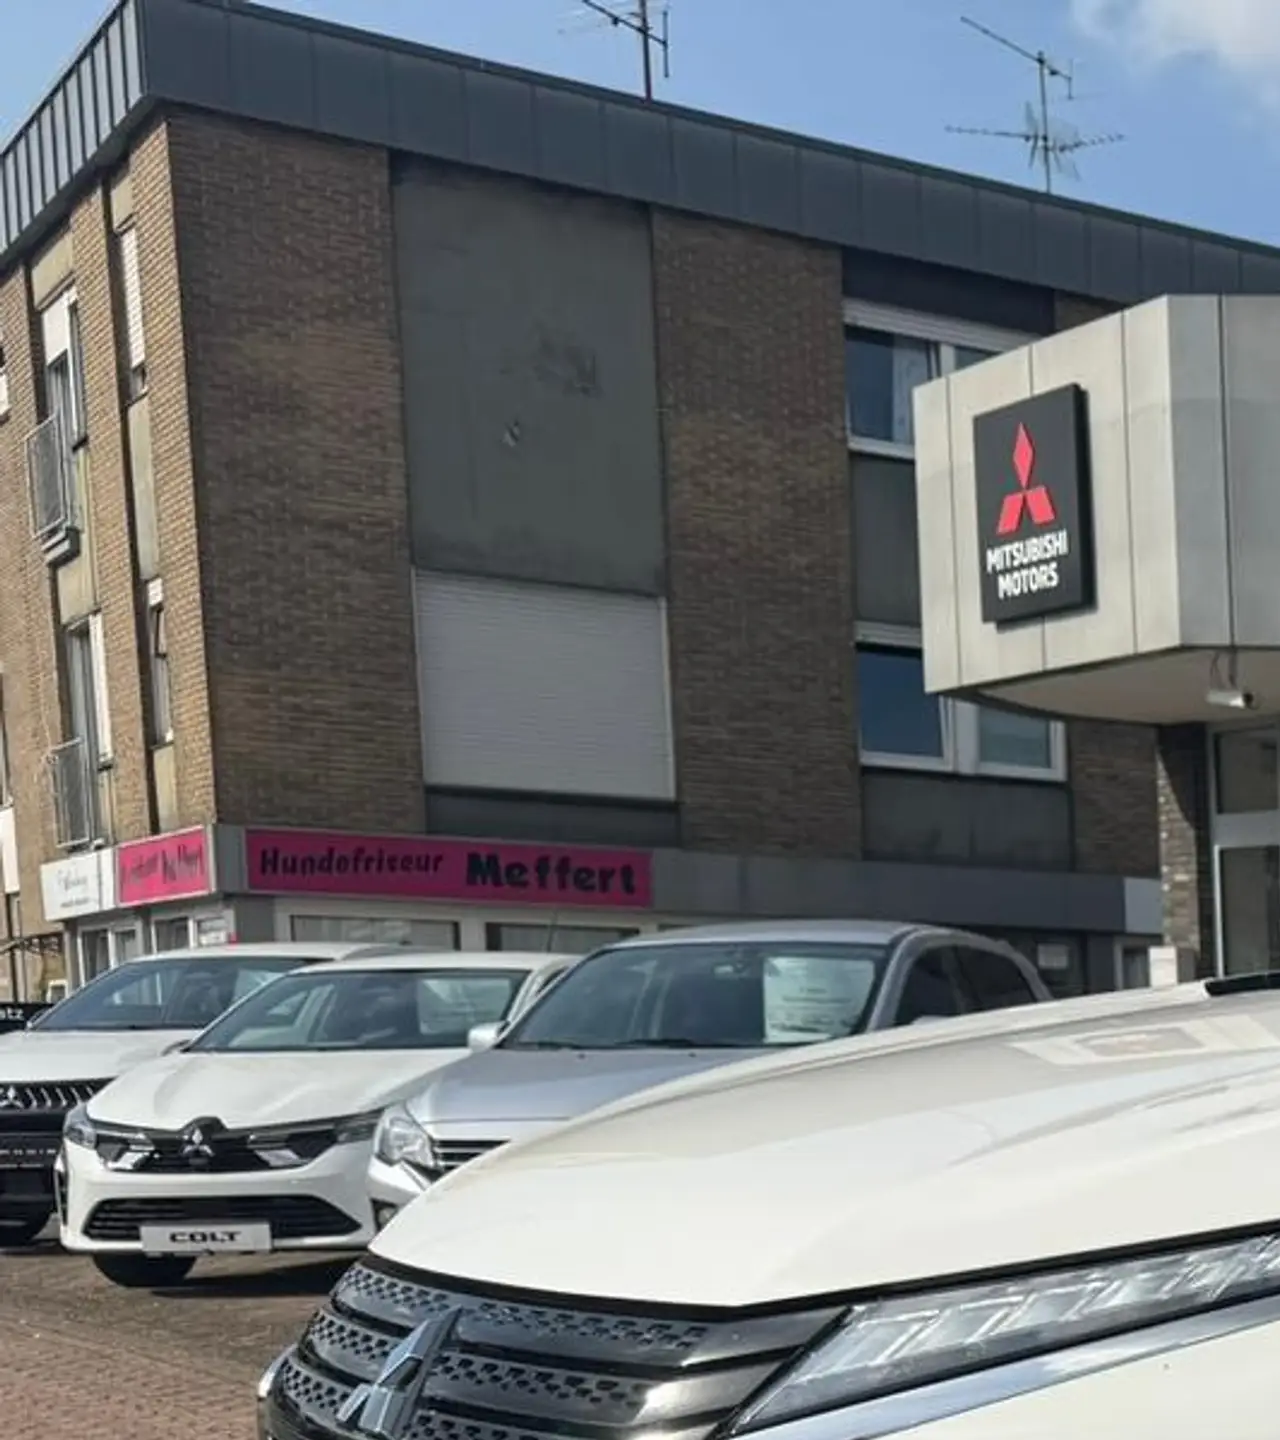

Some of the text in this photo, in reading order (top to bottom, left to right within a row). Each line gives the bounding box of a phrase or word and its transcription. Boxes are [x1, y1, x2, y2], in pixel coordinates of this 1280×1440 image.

[986, 527, 1069, 574] MITSUBISHI
[998, 561, 1059, 600] MOTORS
[465, 851, 637, 895] Meffert
[168, 1230, 242, 1245] COLT
